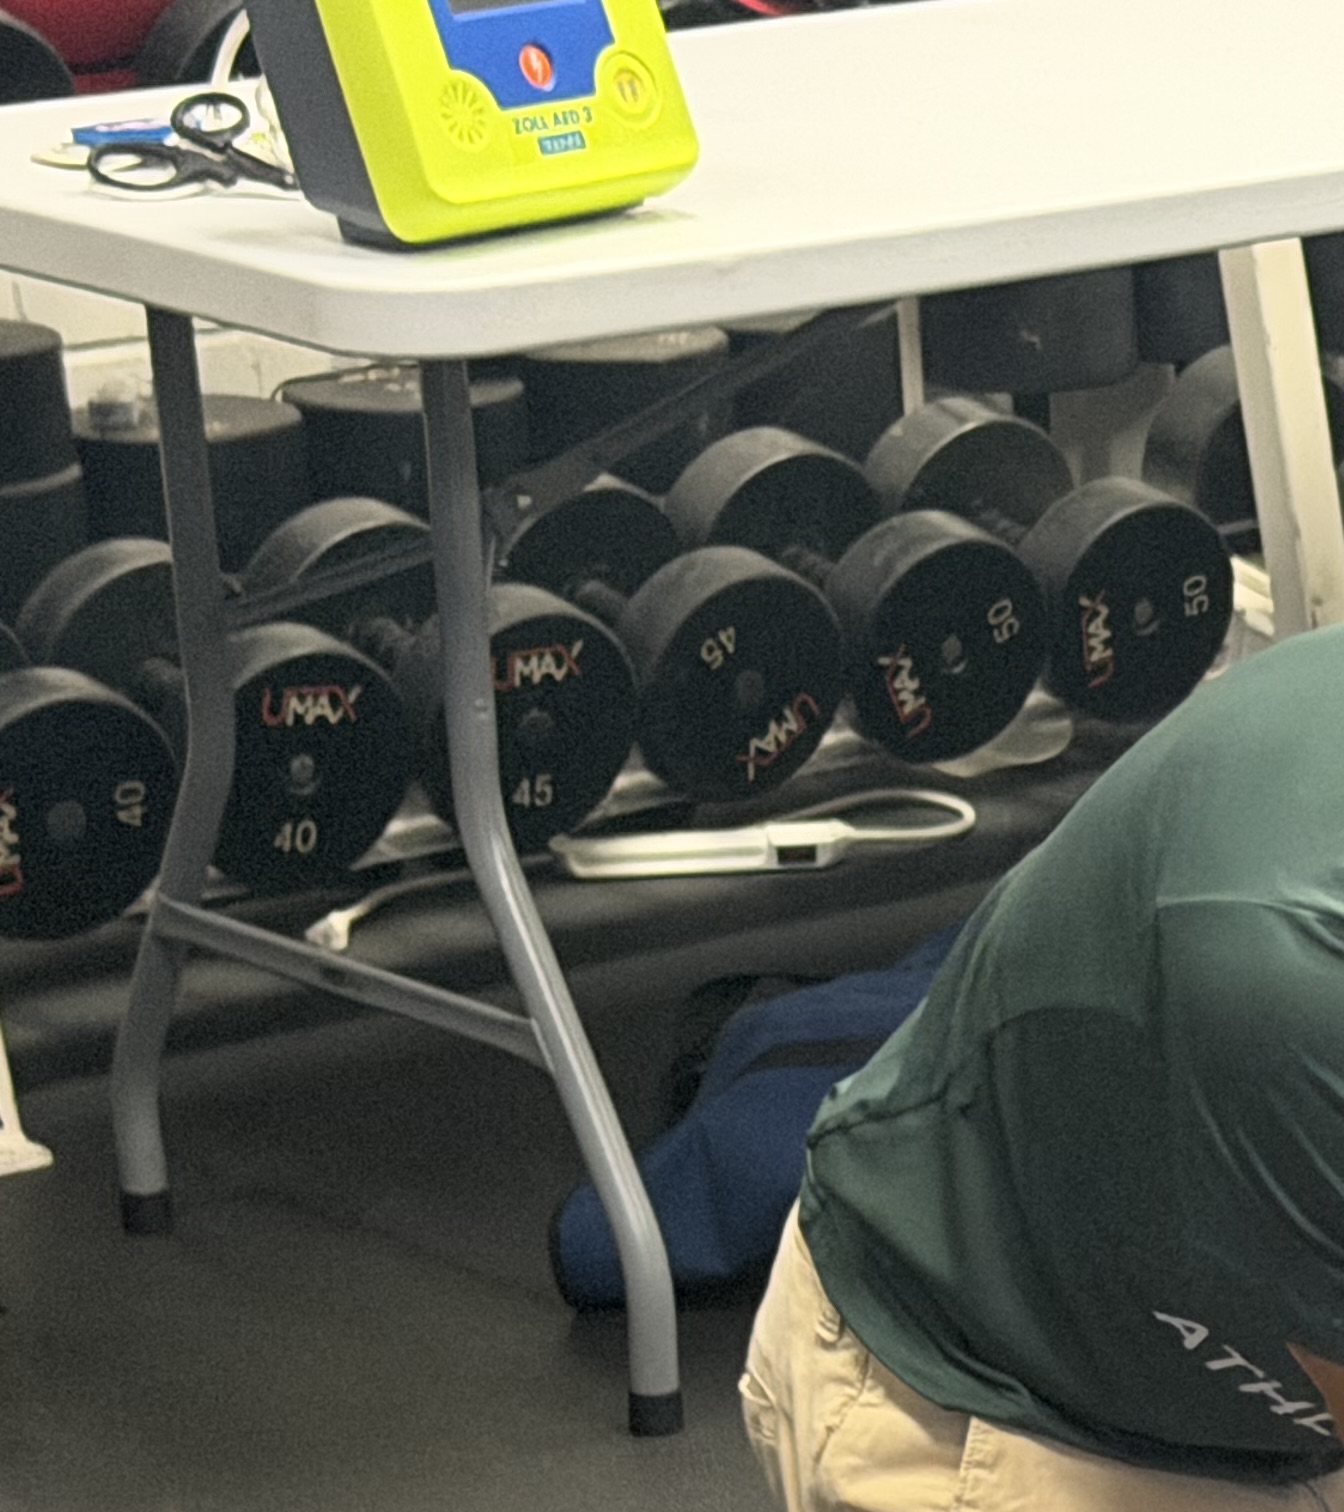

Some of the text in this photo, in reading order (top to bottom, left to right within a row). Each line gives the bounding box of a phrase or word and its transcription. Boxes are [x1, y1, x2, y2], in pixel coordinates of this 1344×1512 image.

[1182, 574, 1210, 618] 50
[986, 598, 1021, 644] 50
[700, 625, 737, 671] 45
[261, 684, 363, 727] UMAX
[735, 691, 821, 783] UMAX
[114, 779, 147, 828] 40
[511, 772, 554, 808] 45
[273, 819, 318, 854] 40
[1152, 1310, 1337, 1437] ATHL
